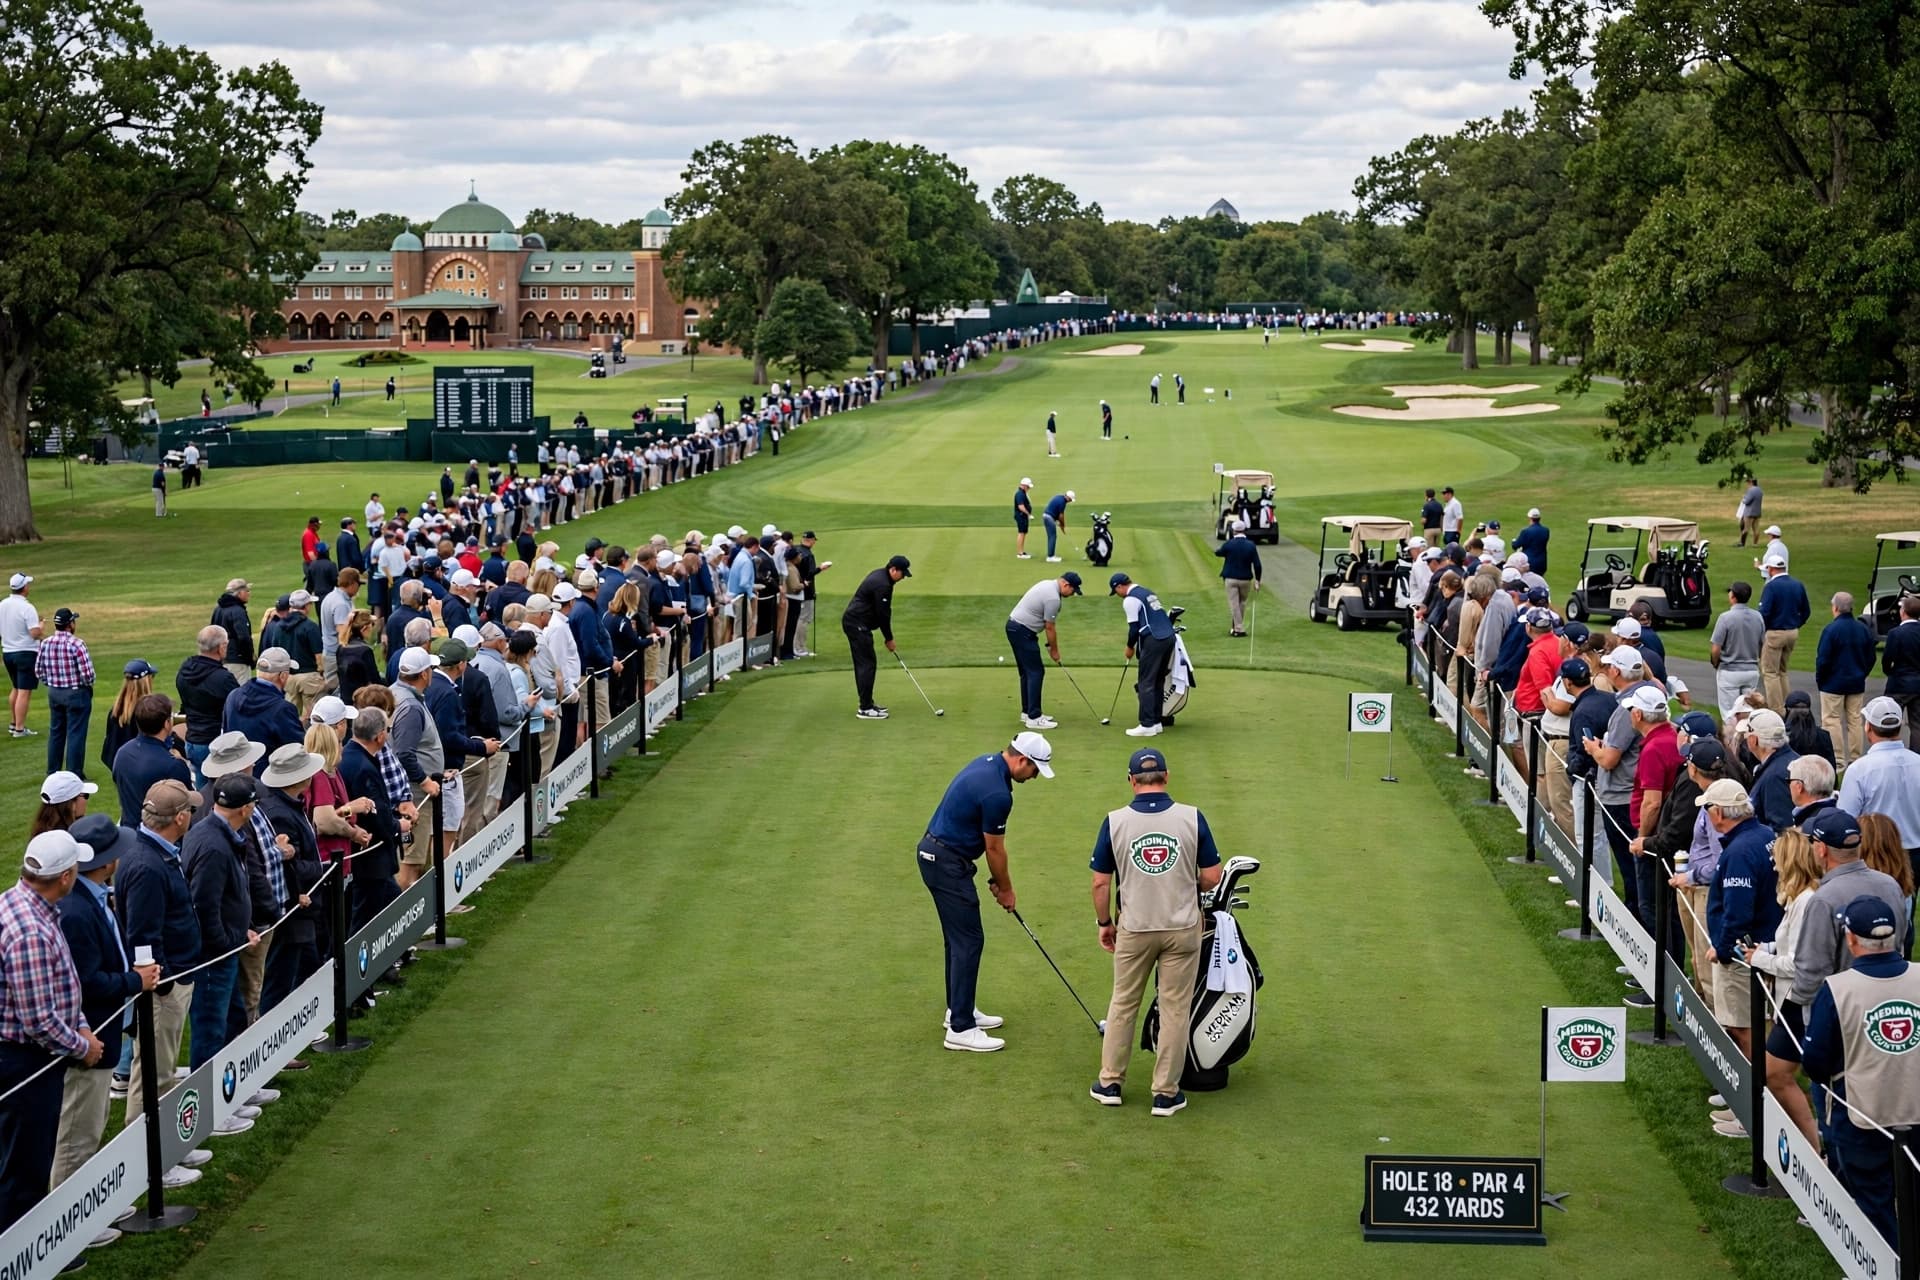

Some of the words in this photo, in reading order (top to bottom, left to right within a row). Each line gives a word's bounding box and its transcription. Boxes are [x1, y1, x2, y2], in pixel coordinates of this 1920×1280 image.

[240, 1046, 261, 1083] BMW
[261, 996, 319, 1062] CHAMPIONSHIP
[1560, 1023, 1612, 1041] MEDINAH
[1382, 1170, 1429, 1192] HOLE
[1433, 1171, 1453, 1192] 18
[1472, 1172, 1508, 1193] PAR
[1513, 1172, 1526, 1194] 4
[1403, 1196, 1439, 1217] 432
[1444, 1197, 1505, 1219] YARDS
[36, 1161, 126, 1262] CHAMPIONSHIP
[1792, 1153, 1812, 1198] BMW
[1812, 1182, 1877, 1280] CHAMPIONSHIP
